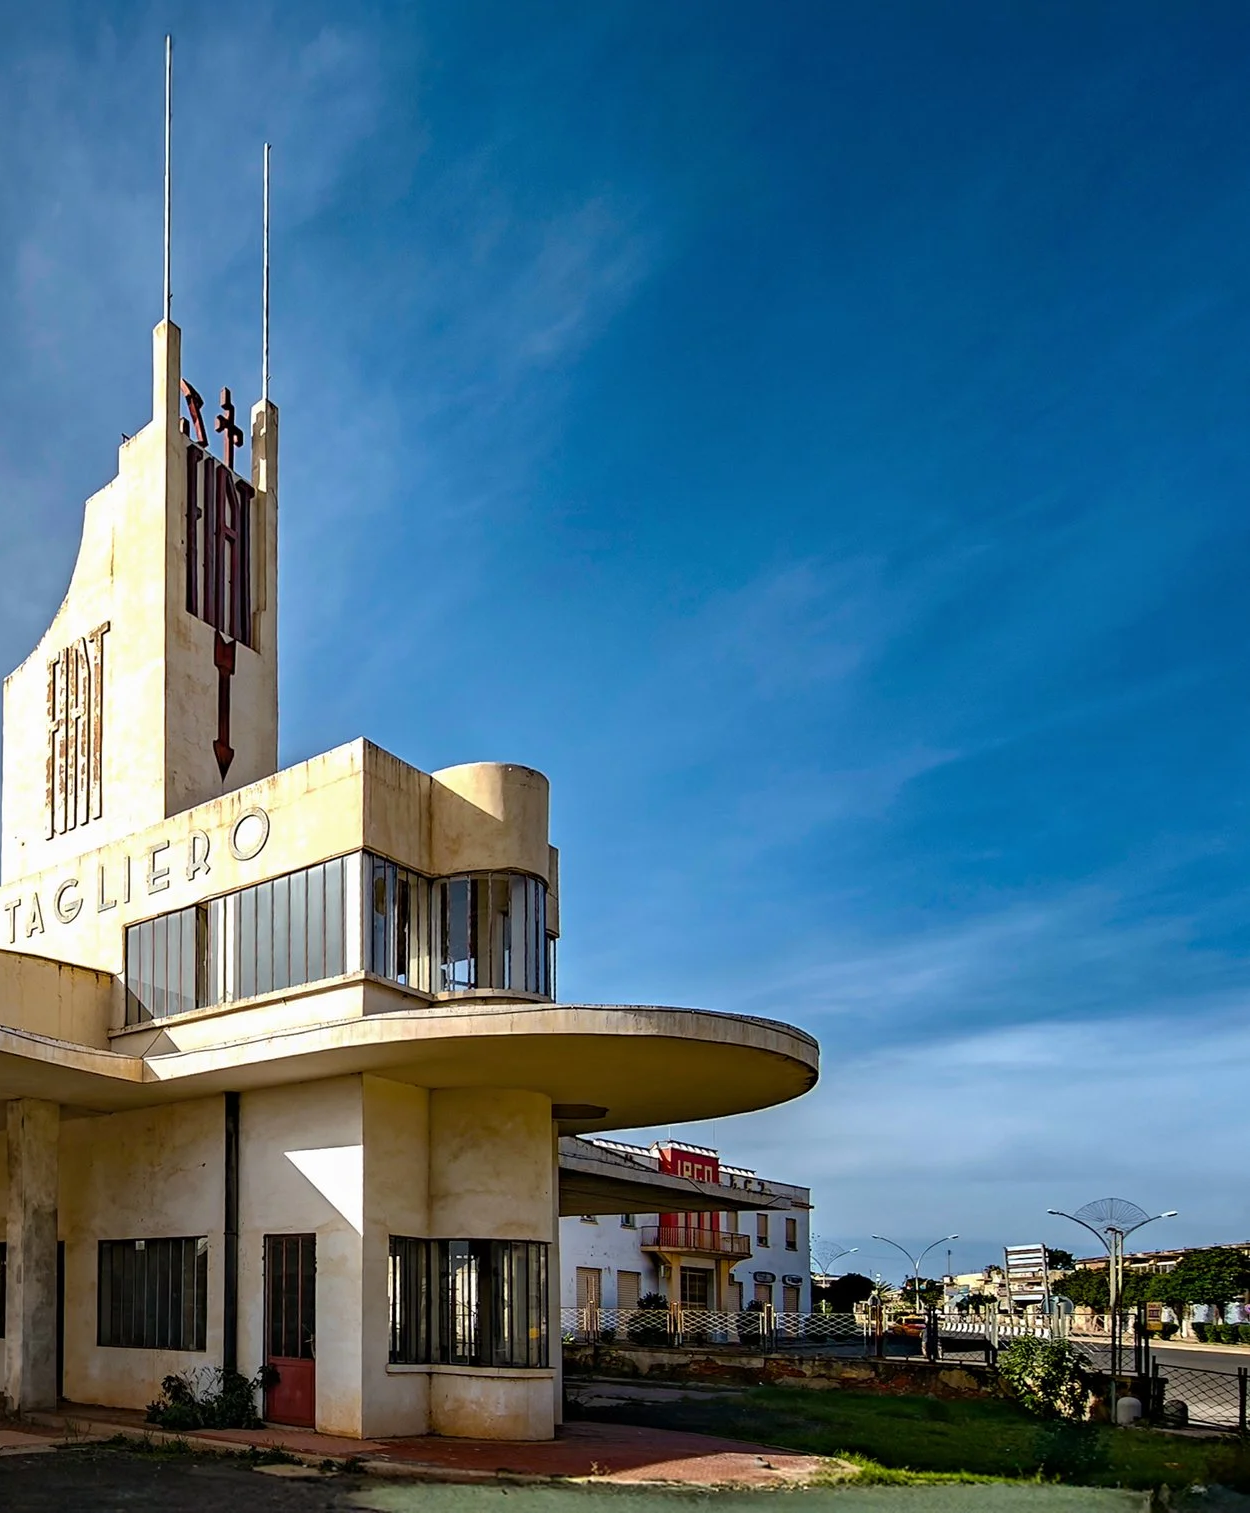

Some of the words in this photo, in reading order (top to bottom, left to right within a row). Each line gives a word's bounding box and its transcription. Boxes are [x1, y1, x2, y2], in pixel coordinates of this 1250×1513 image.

[186, 443, 255, 649] FIAT
[46, 621, 110, 841] FIAT
[4, 806, 270, 943] TAGLIERO
